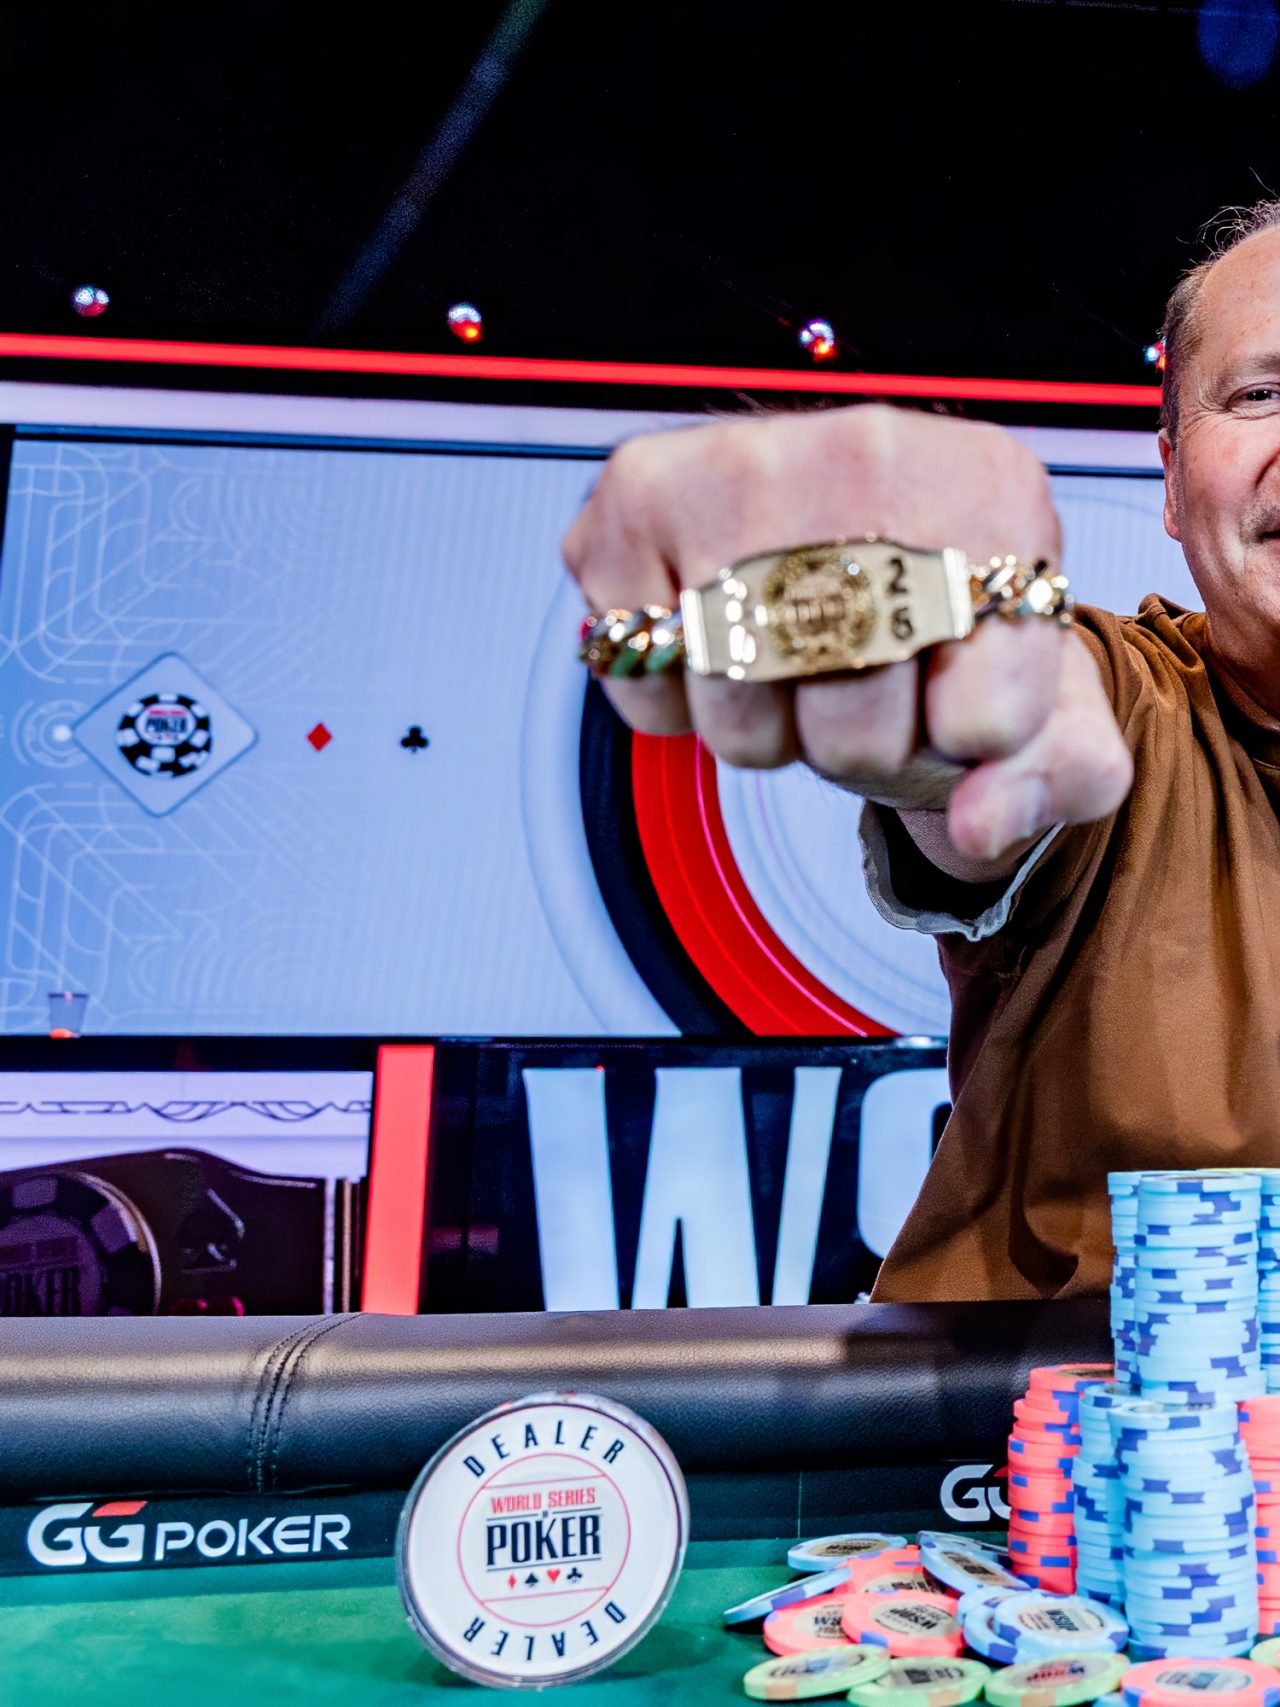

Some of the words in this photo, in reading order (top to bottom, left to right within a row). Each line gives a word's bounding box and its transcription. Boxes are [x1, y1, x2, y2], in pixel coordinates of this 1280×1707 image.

[463, 1420, 625, 1479] DEALER
[490, 1492, 542, 1514] WORLD
[548, 1487, 597, 1509] SERIES
[486, 1514, 601, 1566] POKER
[463, 1600, 628, 1661] DEALER
